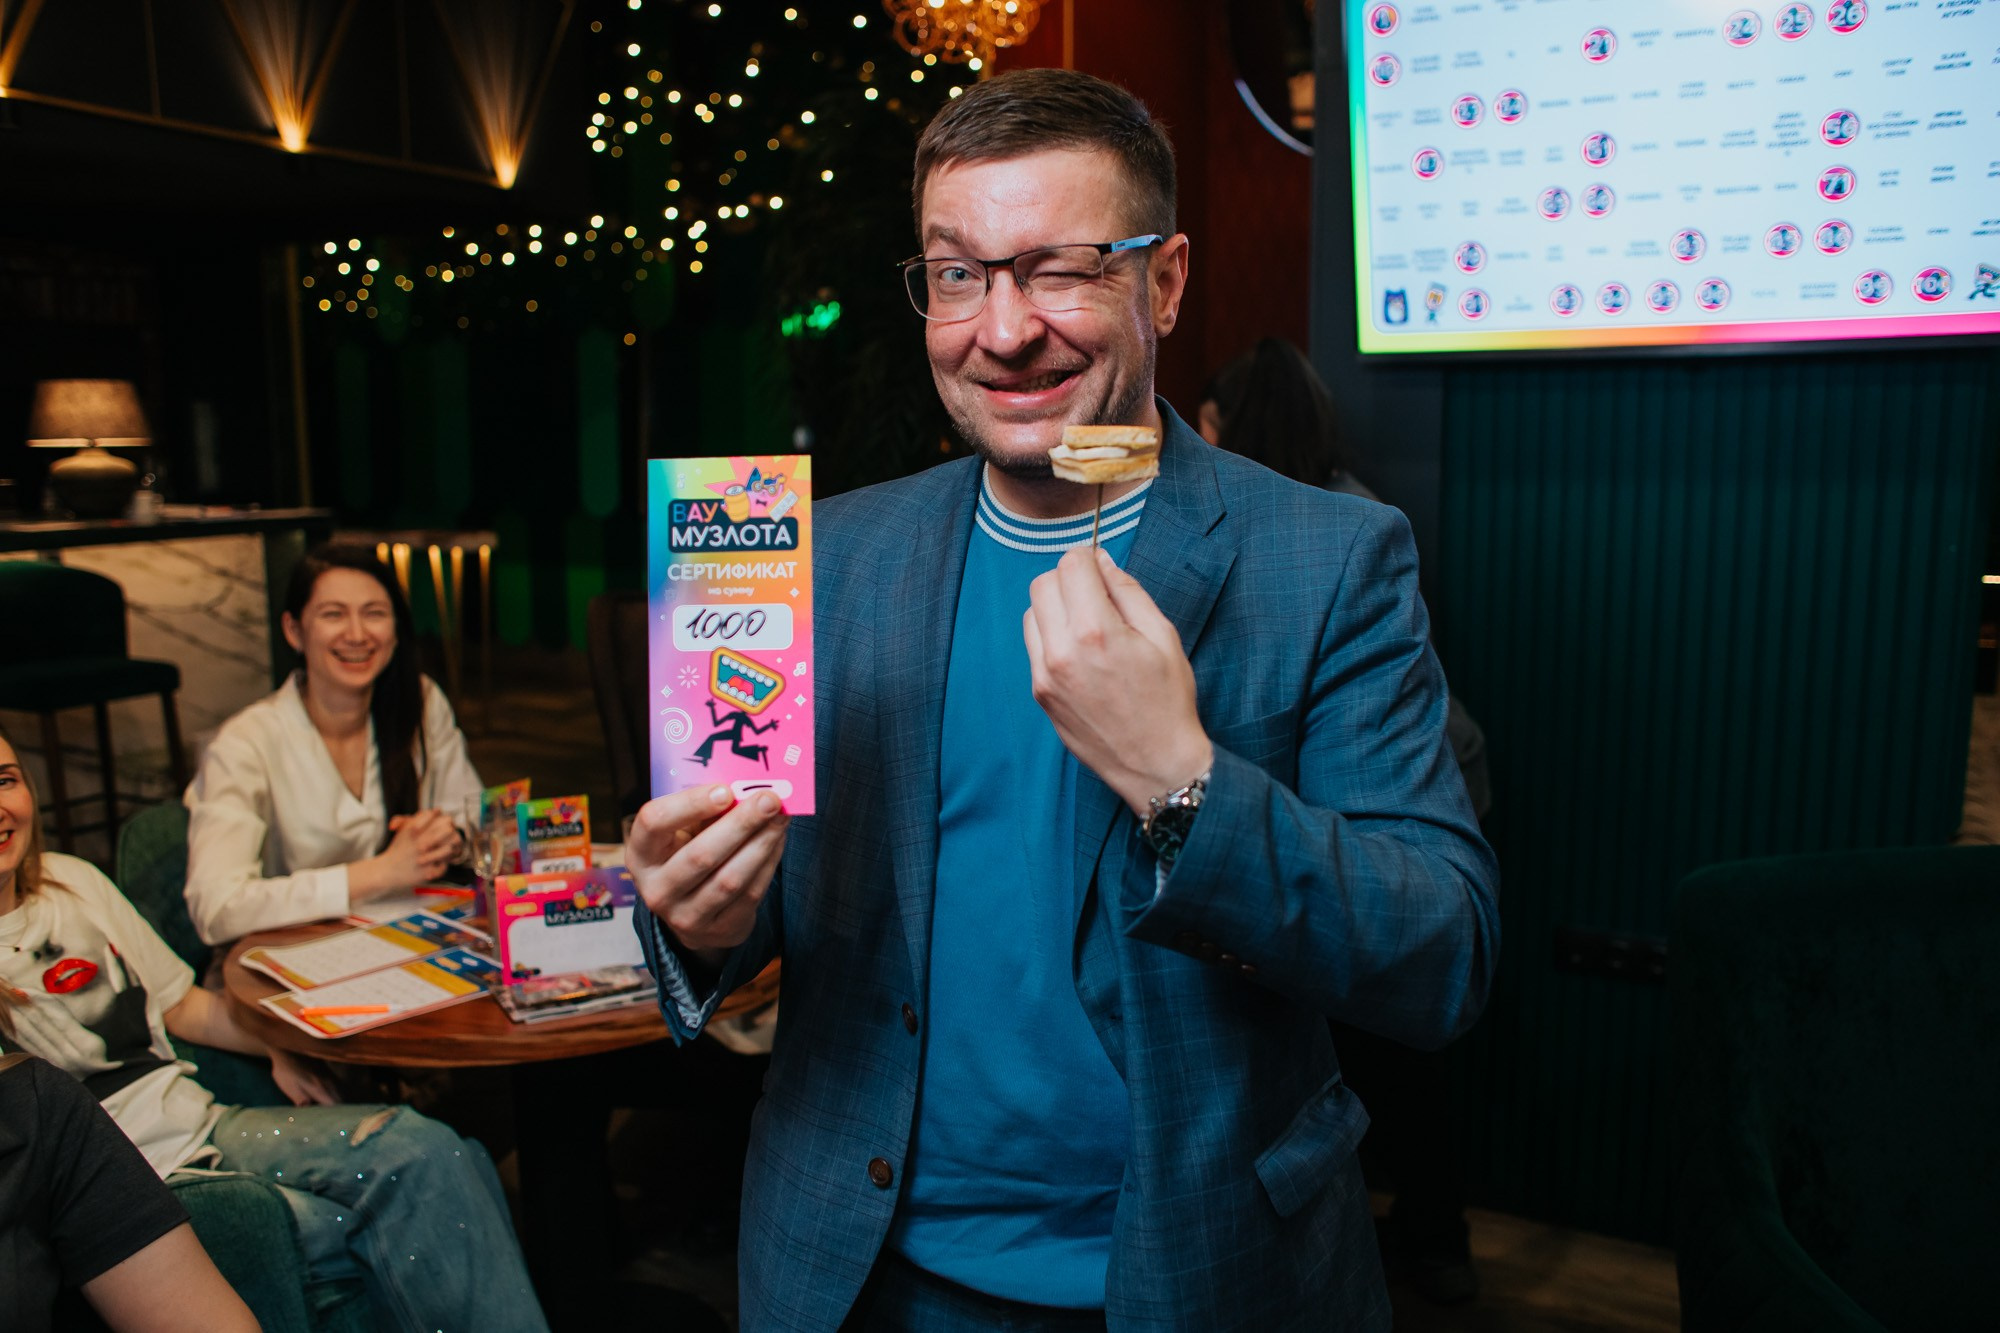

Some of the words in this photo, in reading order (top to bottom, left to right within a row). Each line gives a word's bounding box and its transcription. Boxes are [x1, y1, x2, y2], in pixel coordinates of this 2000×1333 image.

[1829, 2, 1864, 27] 26
[1823, 172, 1851, 195] 71
[673, 502, 719, 523] ВАУ
[671, 524, 793, 548] МУЗЛОТА
[667, 561, 798, 582] СЕРТИФИКАТ
[686, 608, 767, 640] 1000
